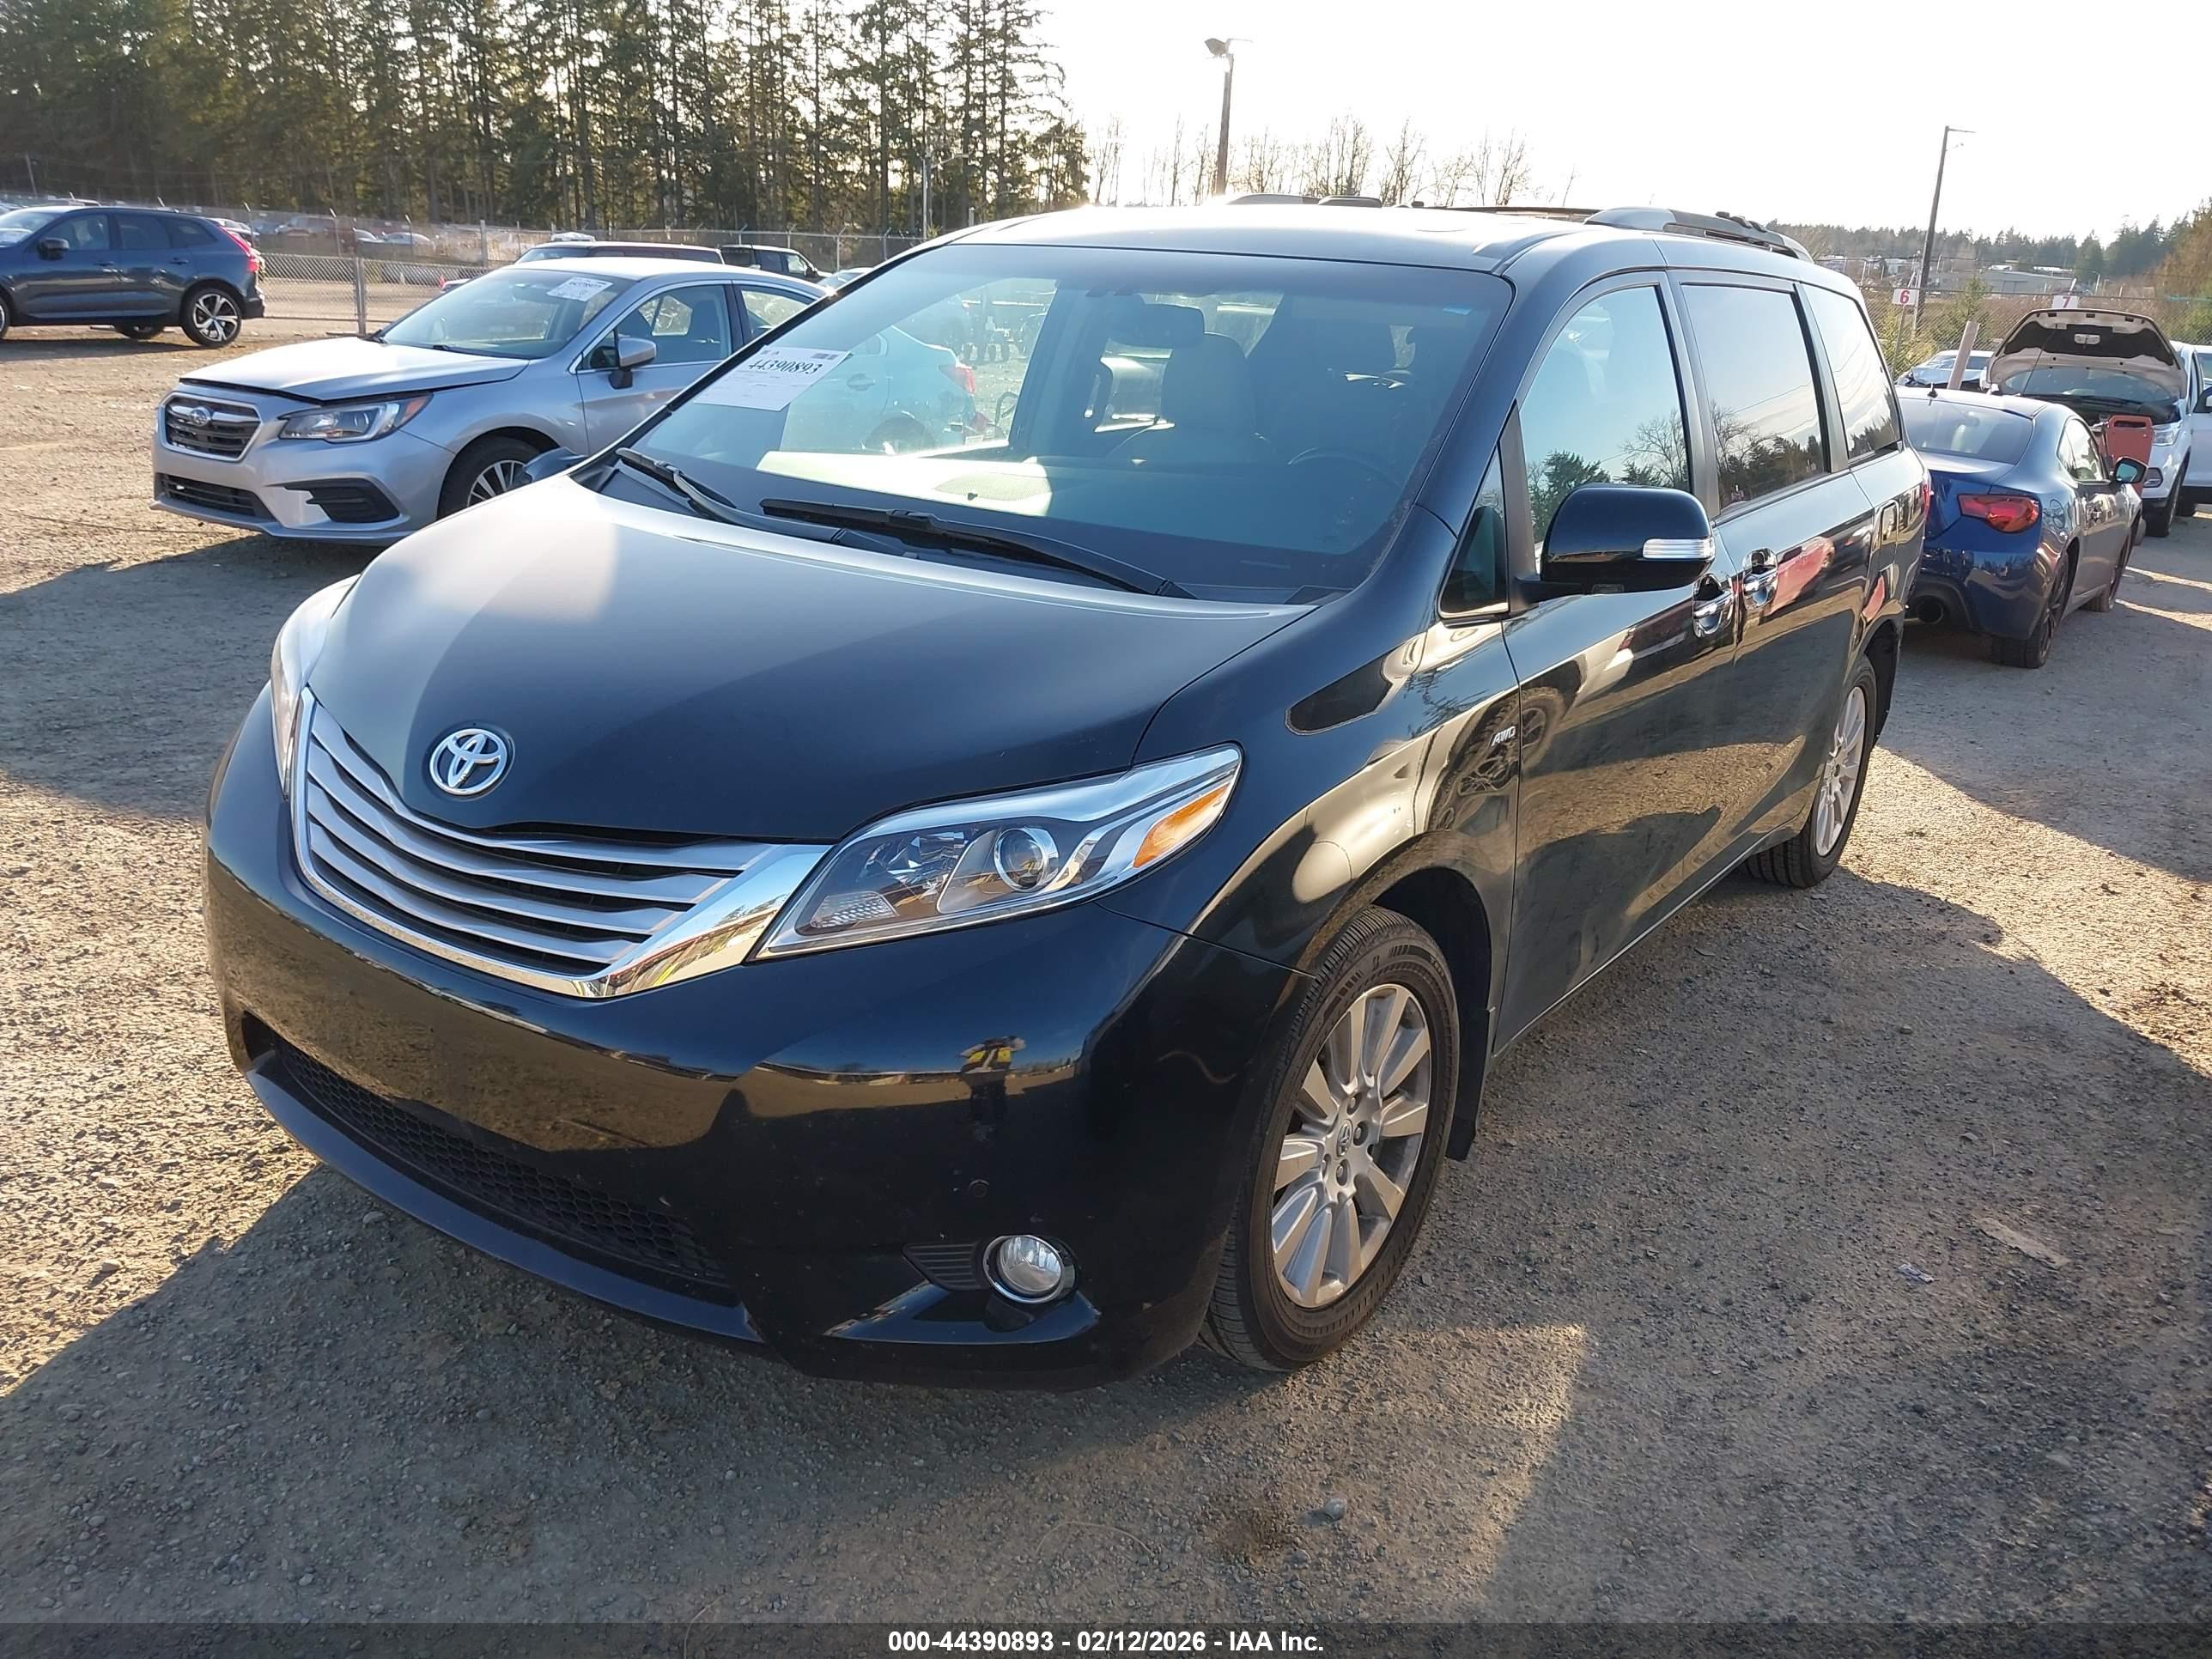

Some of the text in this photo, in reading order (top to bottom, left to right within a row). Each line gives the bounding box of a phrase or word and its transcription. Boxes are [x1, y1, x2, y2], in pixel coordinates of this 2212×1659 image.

[1899, 289, 1911, 304] 6
[2063, 296, 2071, 308] 7
[749, 359, 823, 374] 44390893
[1491, 726, 1516, 747] AWD
